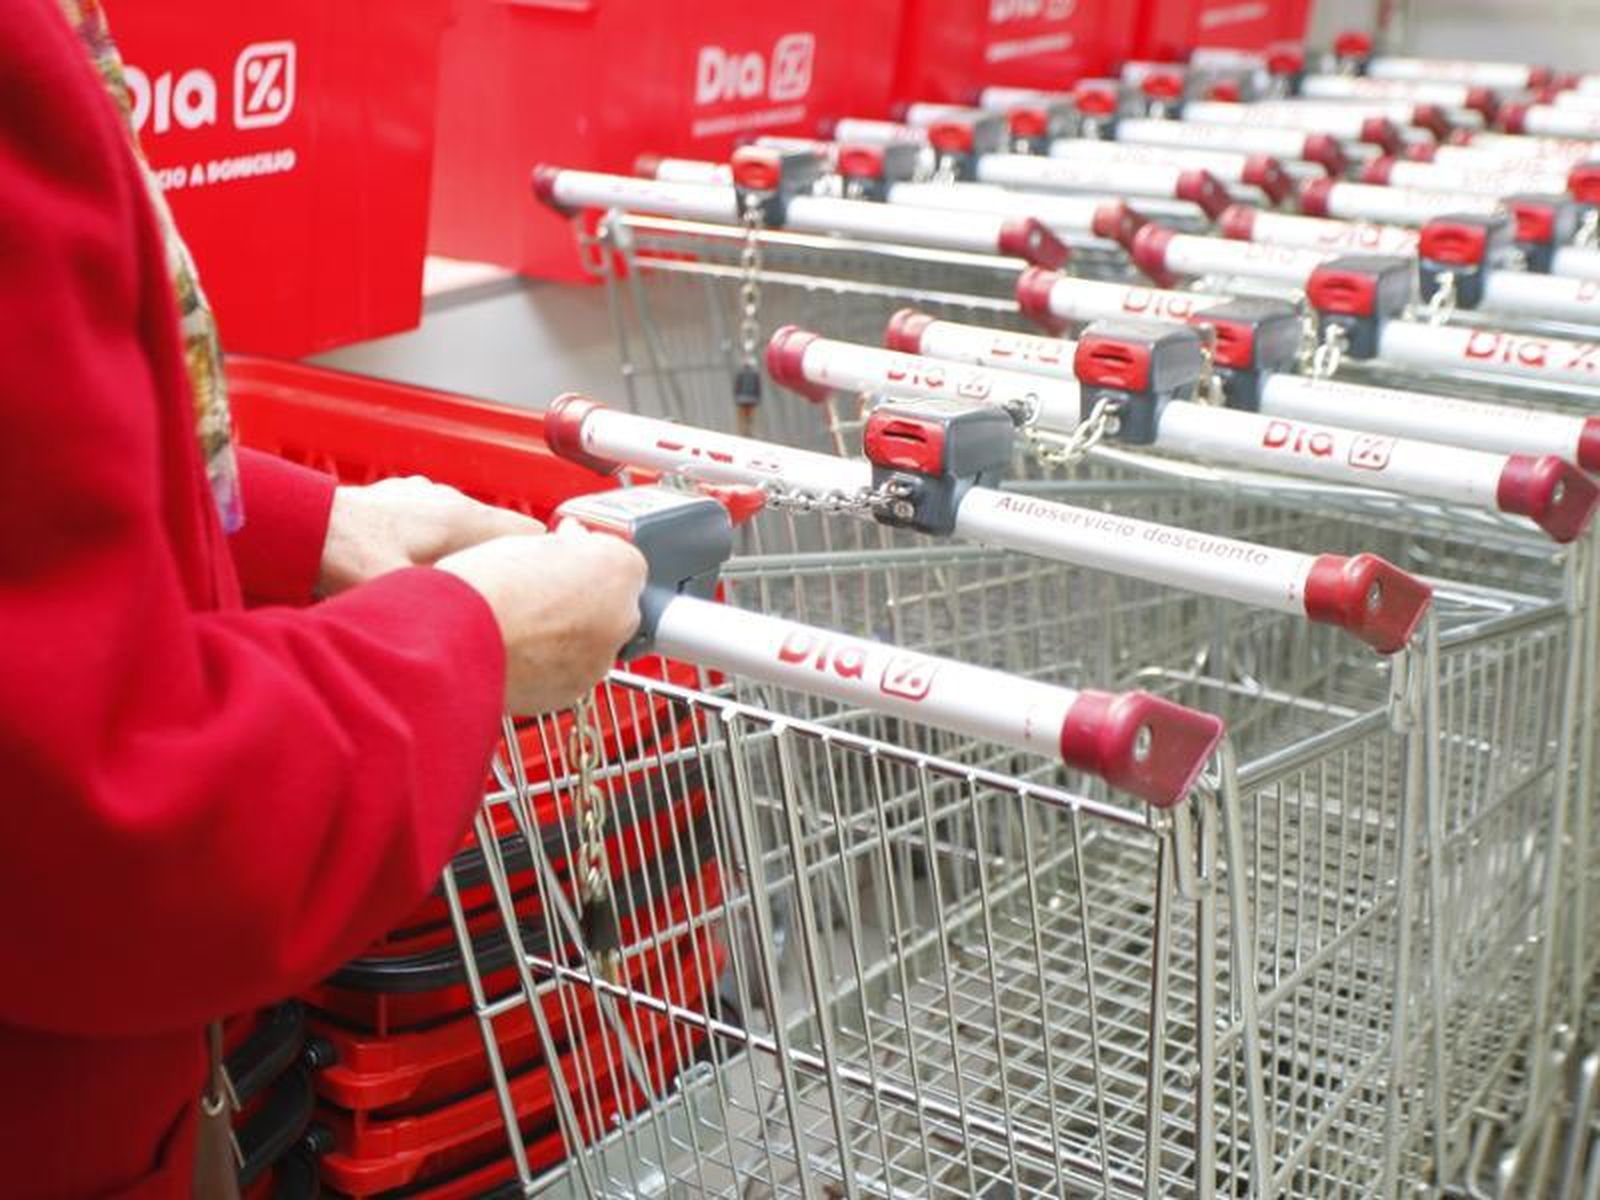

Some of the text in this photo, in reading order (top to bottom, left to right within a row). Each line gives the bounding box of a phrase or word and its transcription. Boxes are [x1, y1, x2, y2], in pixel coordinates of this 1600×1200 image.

[1262, 420, 1333, 457] Dia
[994, 494, 1270, 567] Autoservicio descuento
[776, 629, 864, 680] Dia
